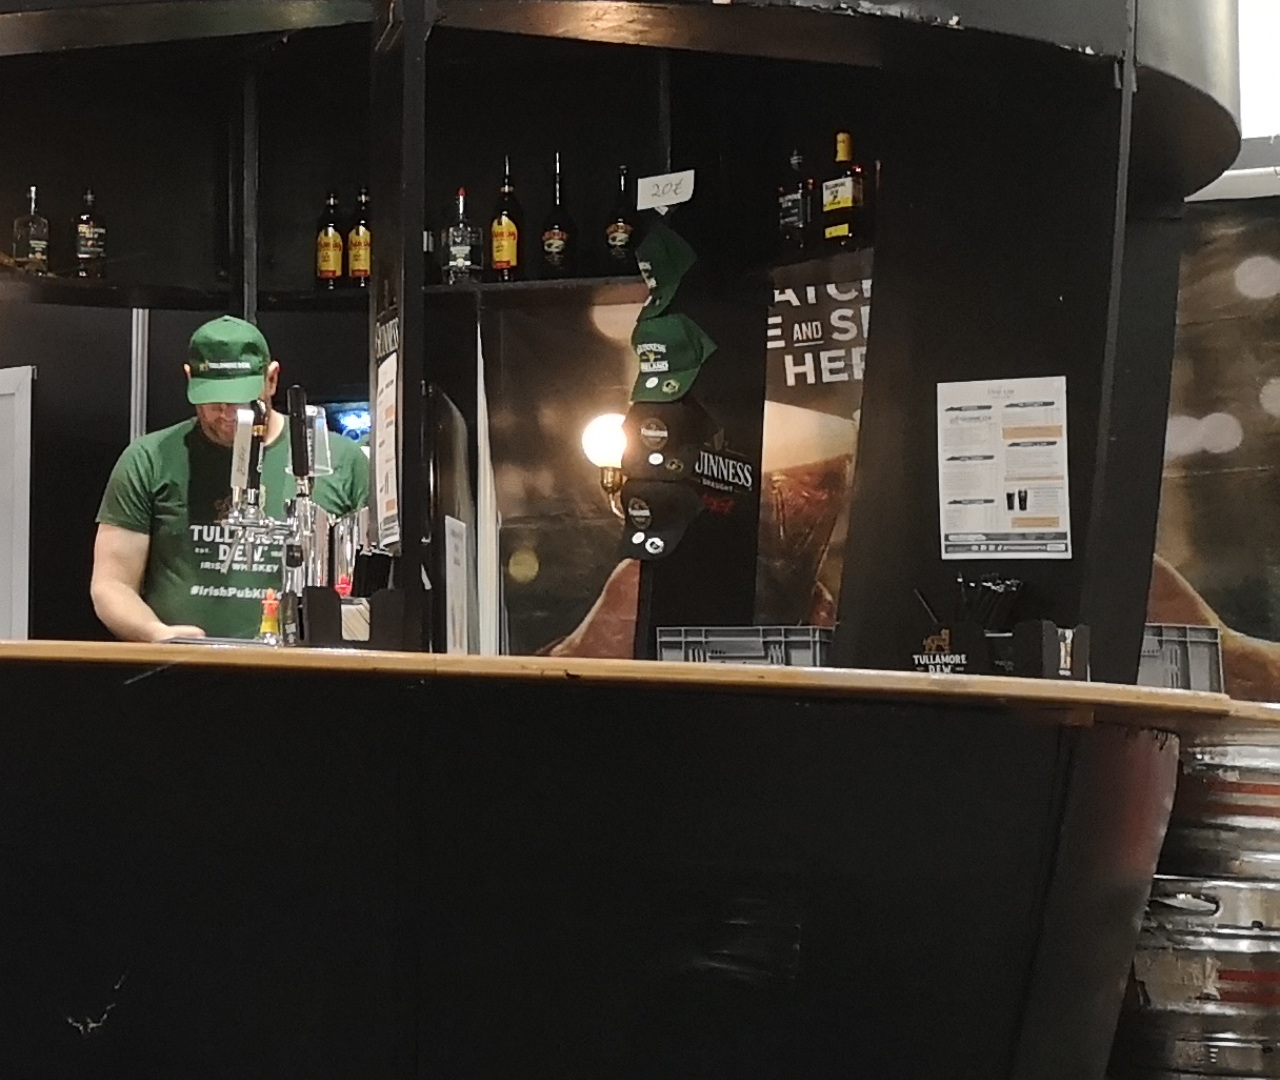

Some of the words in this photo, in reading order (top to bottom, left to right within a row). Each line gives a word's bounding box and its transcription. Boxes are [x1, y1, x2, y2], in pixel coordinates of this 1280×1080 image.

[793, 321, 823, 341] AND
[695, 450, 753, 488] UINNESS
[912, 653, 967, 665] TULLAMORE
